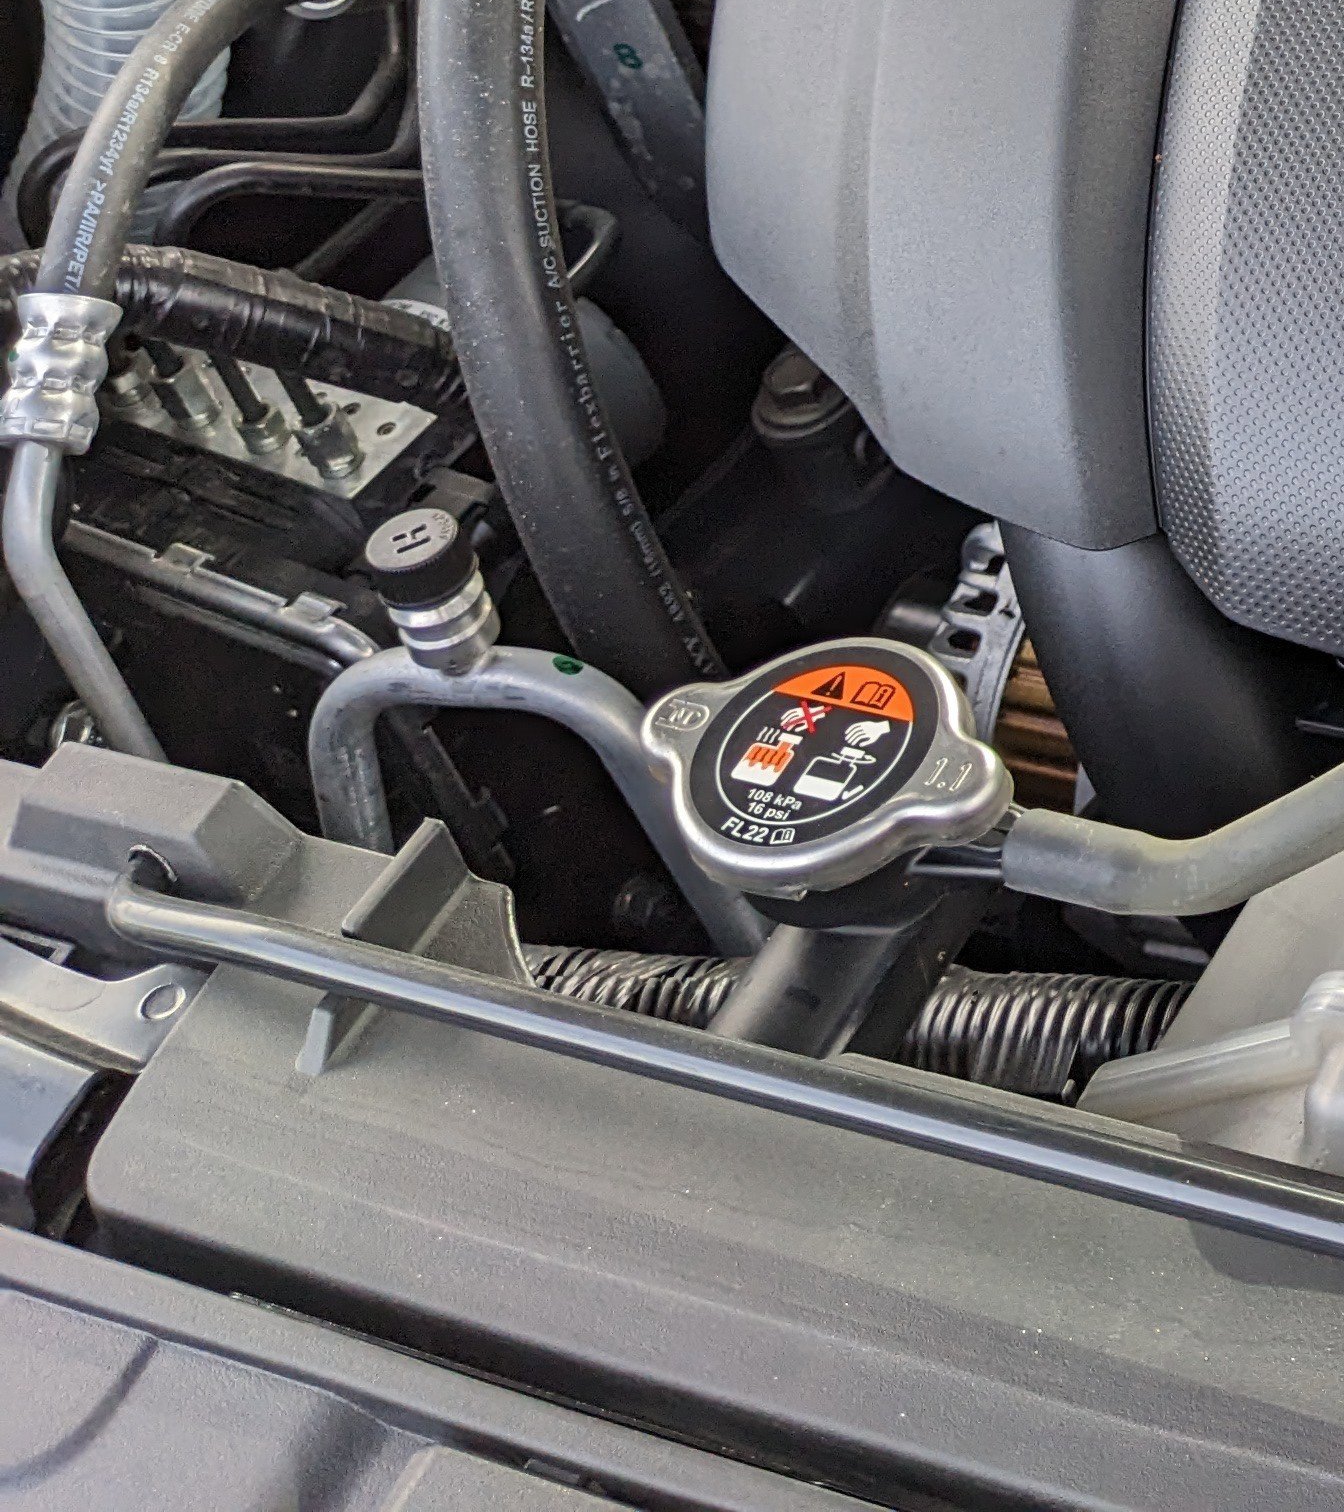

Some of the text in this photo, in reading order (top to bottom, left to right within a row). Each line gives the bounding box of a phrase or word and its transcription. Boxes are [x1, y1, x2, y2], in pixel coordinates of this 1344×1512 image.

[521, 100, 540, 153] HOSE
[527, 163, 557, 250] SUCTION
[542, 255, 562, 289] A/C
[924, 757, 973, 792] 1.1
[747, 788, 803, 811] 108 kPa
[748, 802, 792, 821] 16 psi
[720, 816, 770, 843] FL22
